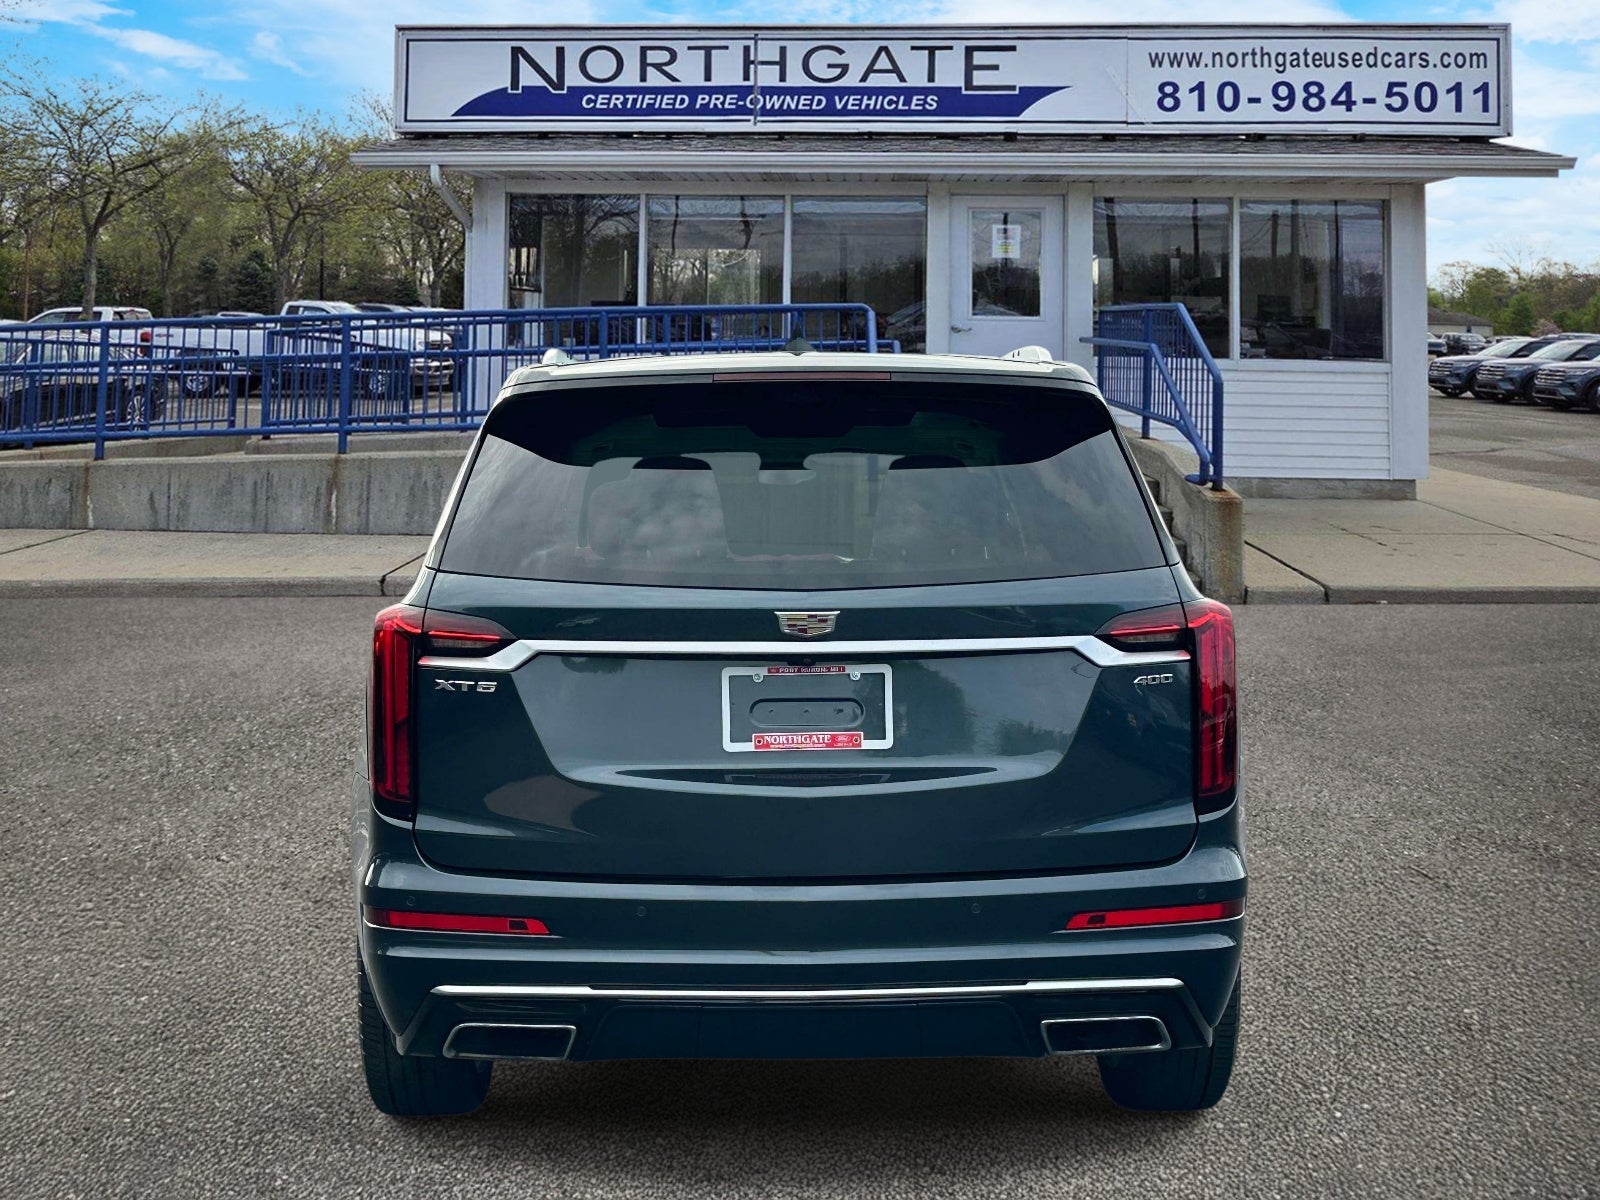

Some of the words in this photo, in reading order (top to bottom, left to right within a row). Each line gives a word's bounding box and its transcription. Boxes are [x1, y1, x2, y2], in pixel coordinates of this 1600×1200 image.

[509, 44, 1018, 92] NORTHGATE
[1148, 46, 1489, 74] www.northgateusedcars.com
[581, 94, 689, 110] CERTIFIED
[695, 94, 827, 110] PRE-OWNED
[834, 95, 939, 110] VEHICLES
[1156, 80, 1491, 113] 810-984-5011
[434, 679, 498, 693] XT6
[763, 734, 832, 744] NORTHGATE
